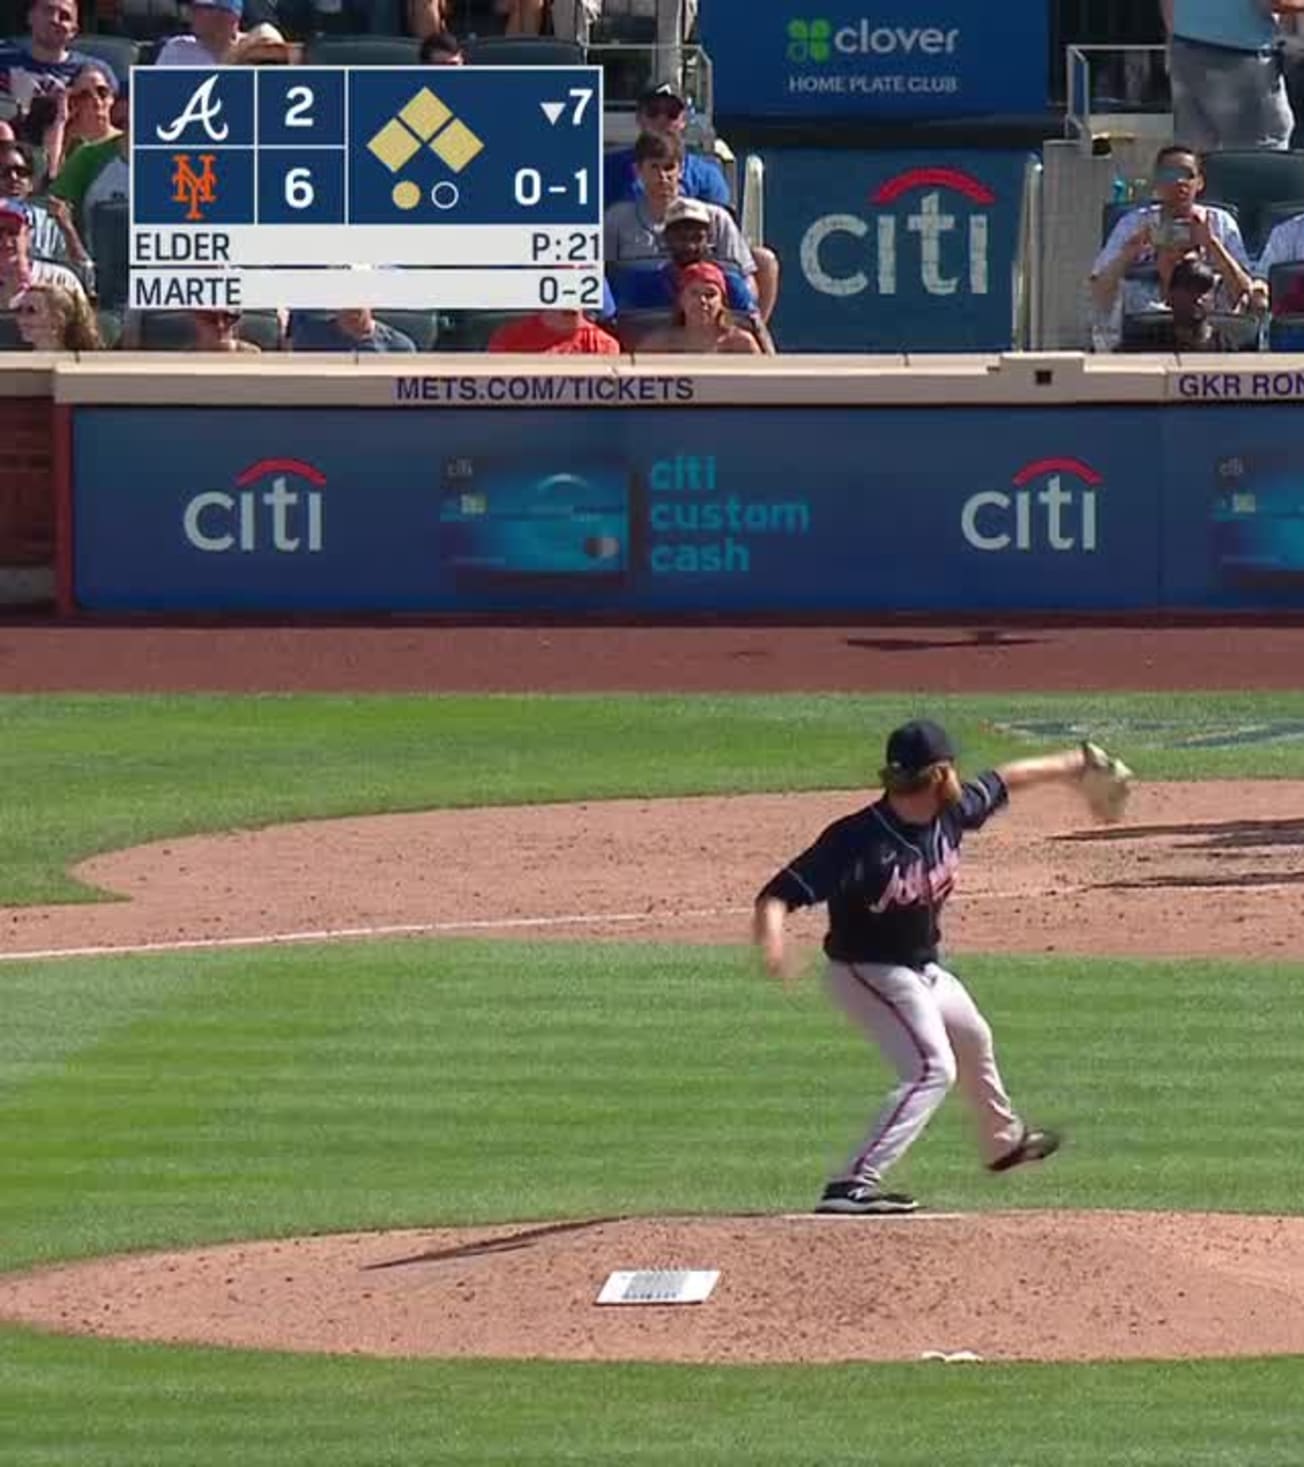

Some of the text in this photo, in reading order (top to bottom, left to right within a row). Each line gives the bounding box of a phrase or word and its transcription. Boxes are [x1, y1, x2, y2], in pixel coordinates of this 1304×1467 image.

[834, 18, 958, 54] clover
[789, 76, 958, 92] HOME PLATE CLUB
[800, 191, 988, 295] citi
[396, 376, 695, 400] METS.COM/TICKETS
[1178, 374, 1241, 396] GKR
[652, 455, 716, 490] citi
[184, 476, 322, 551] citi
[652, 496, 811, 533] custom
[961, 474, 1096, 550] citi
[652, 538, 750, 572] cash
